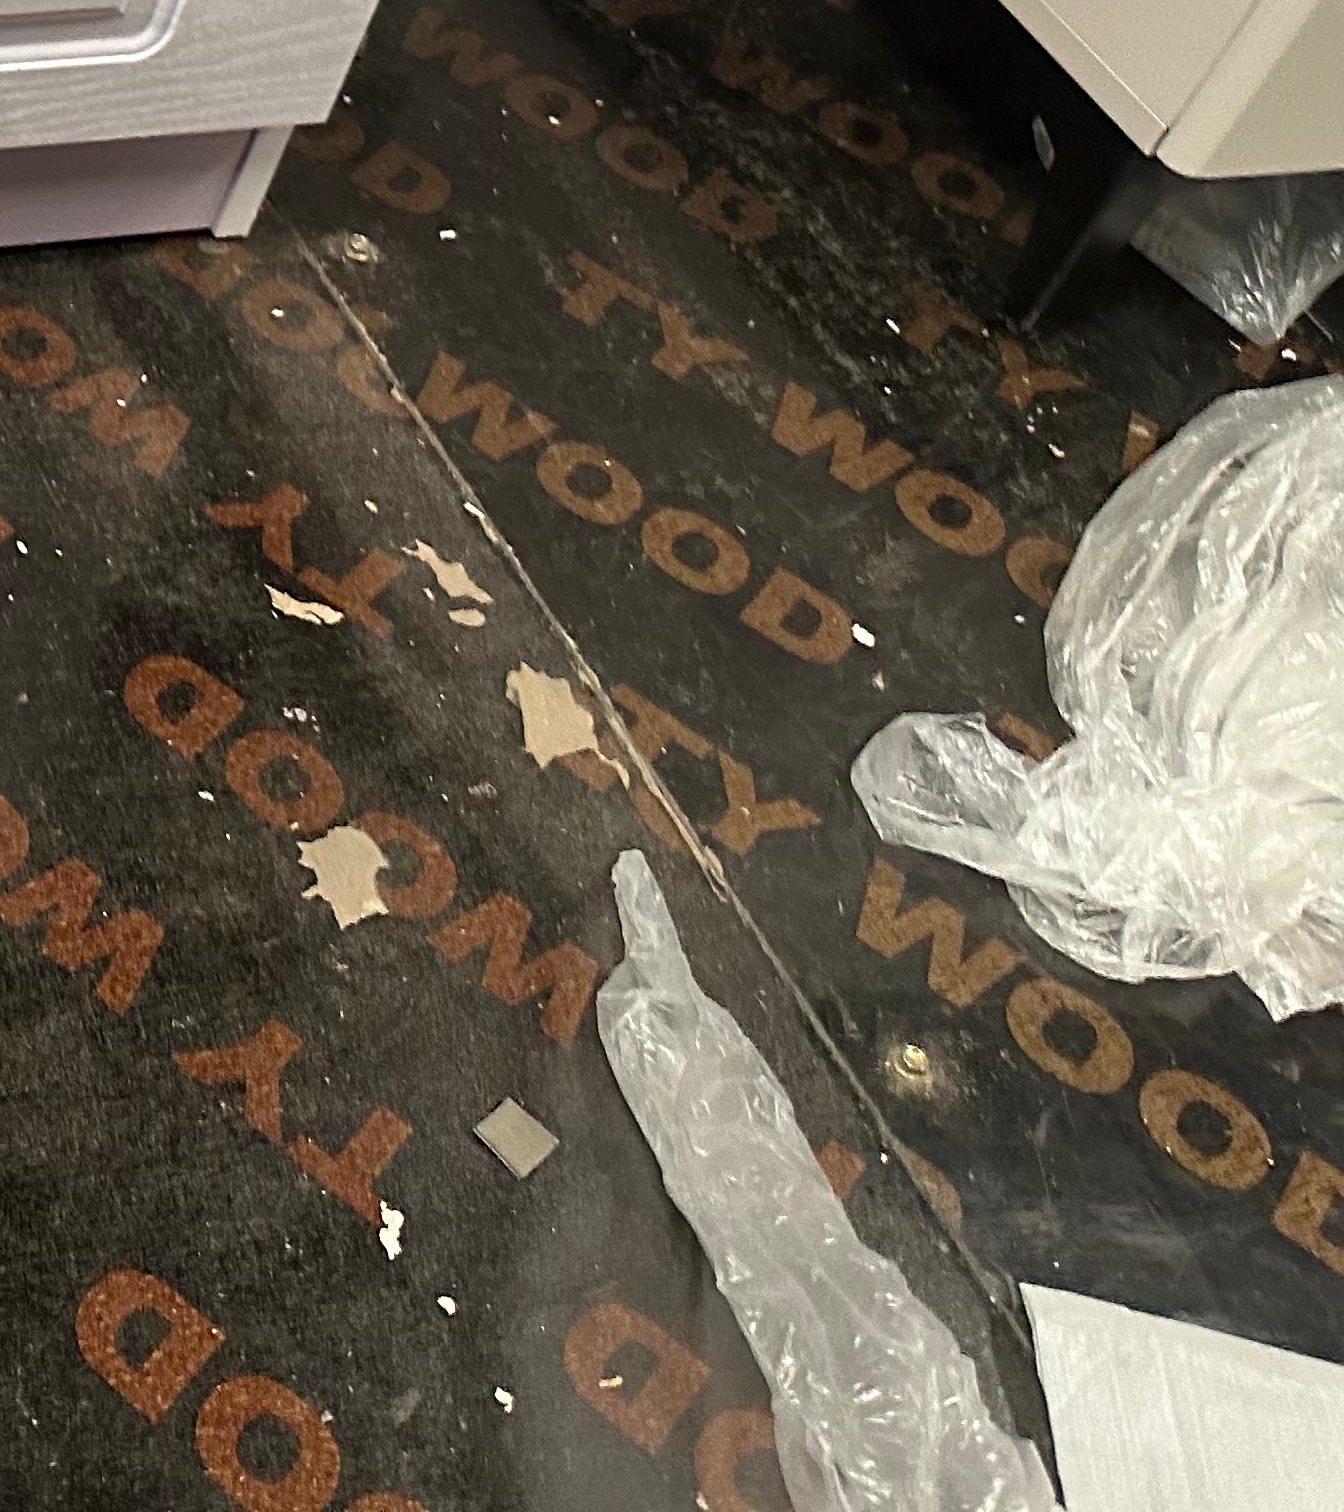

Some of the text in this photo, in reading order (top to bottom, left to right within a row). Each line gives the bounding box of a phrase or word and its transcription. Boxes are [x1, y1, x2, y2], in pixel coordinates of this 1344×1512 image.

[404, 8, 778, 245] WOOD
[204, 483, 407, 639] TY
[417, 350, 854, 664] WOOD
[562, 252, 1074, 608] TY WOO
[124, 654, 598, 1047] WOOD
[173, 1021, 412, 1229] TY
